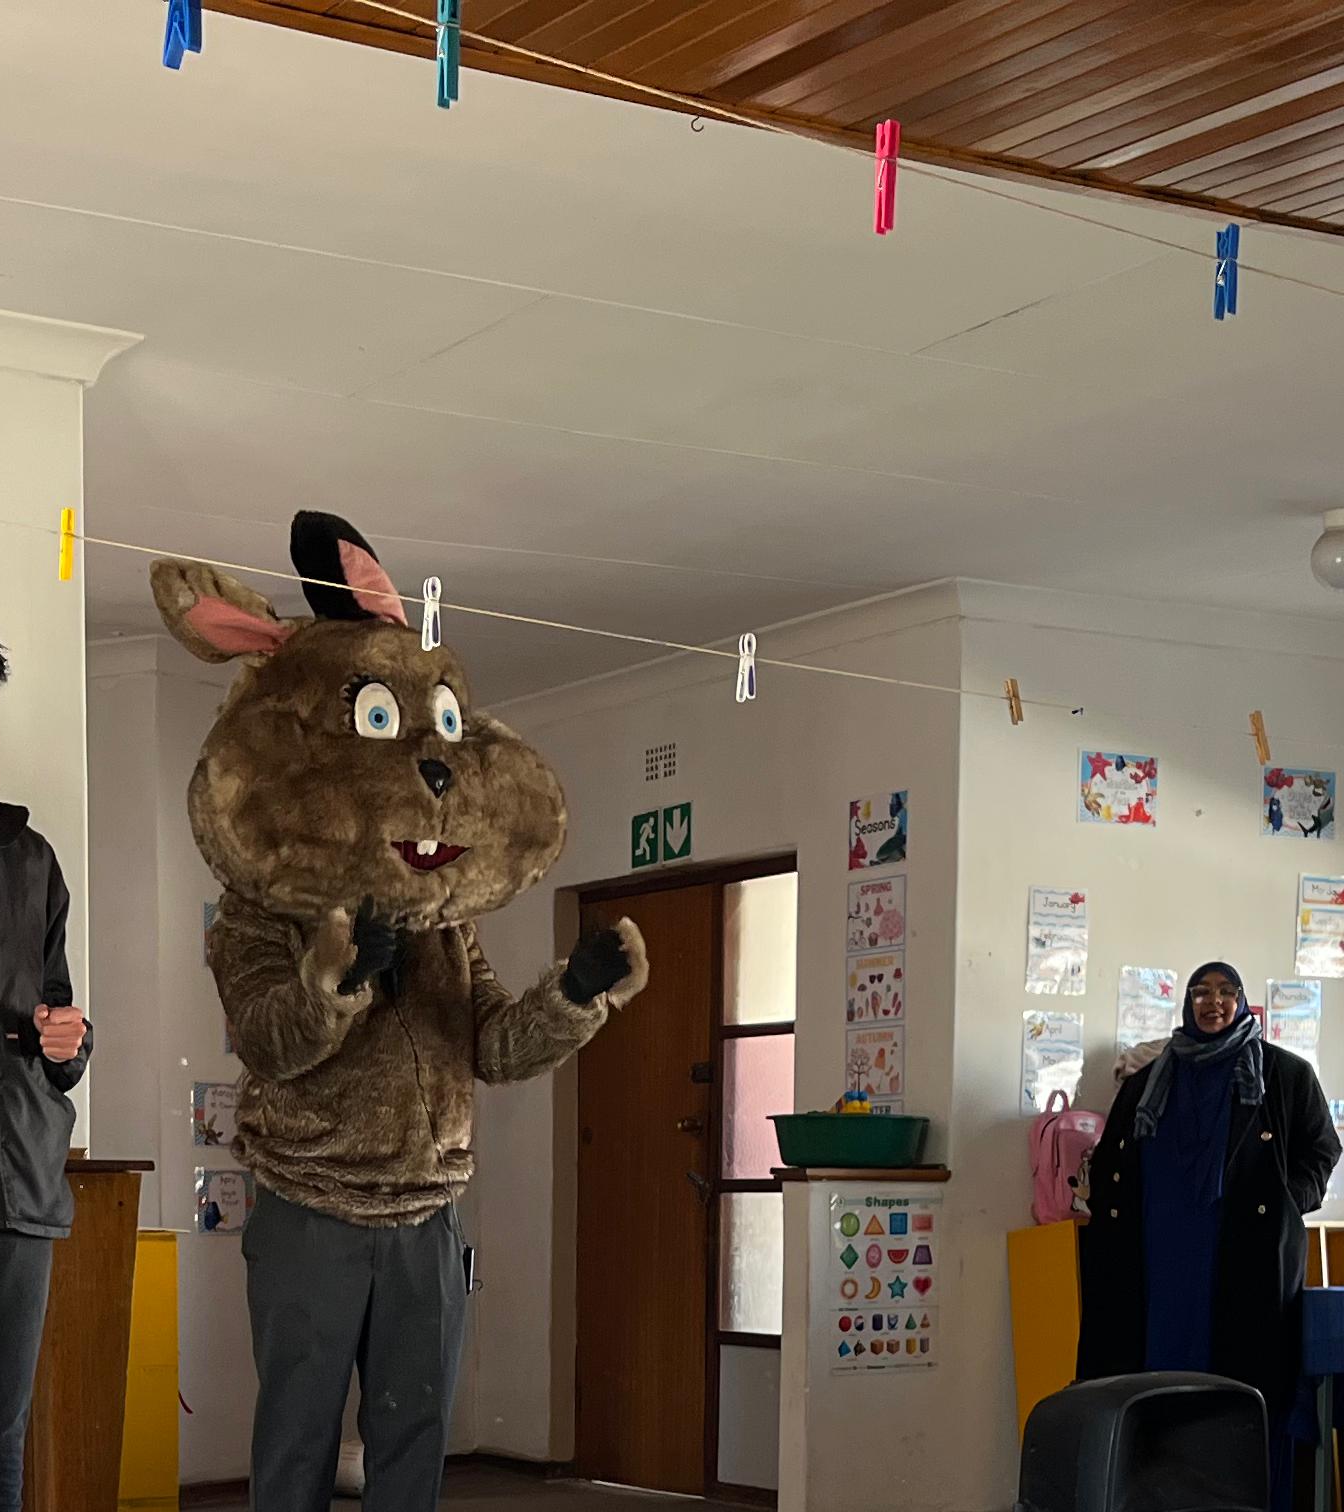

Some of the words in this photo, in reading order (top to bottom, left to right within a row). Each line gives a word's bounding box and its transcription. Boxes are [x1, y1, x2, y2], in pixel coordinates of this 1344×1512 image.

[855, 819, 896, 836] Seasons
[860, 881, 892, 896] SPRING
[865, 1196, 910, 1209] Shapes
